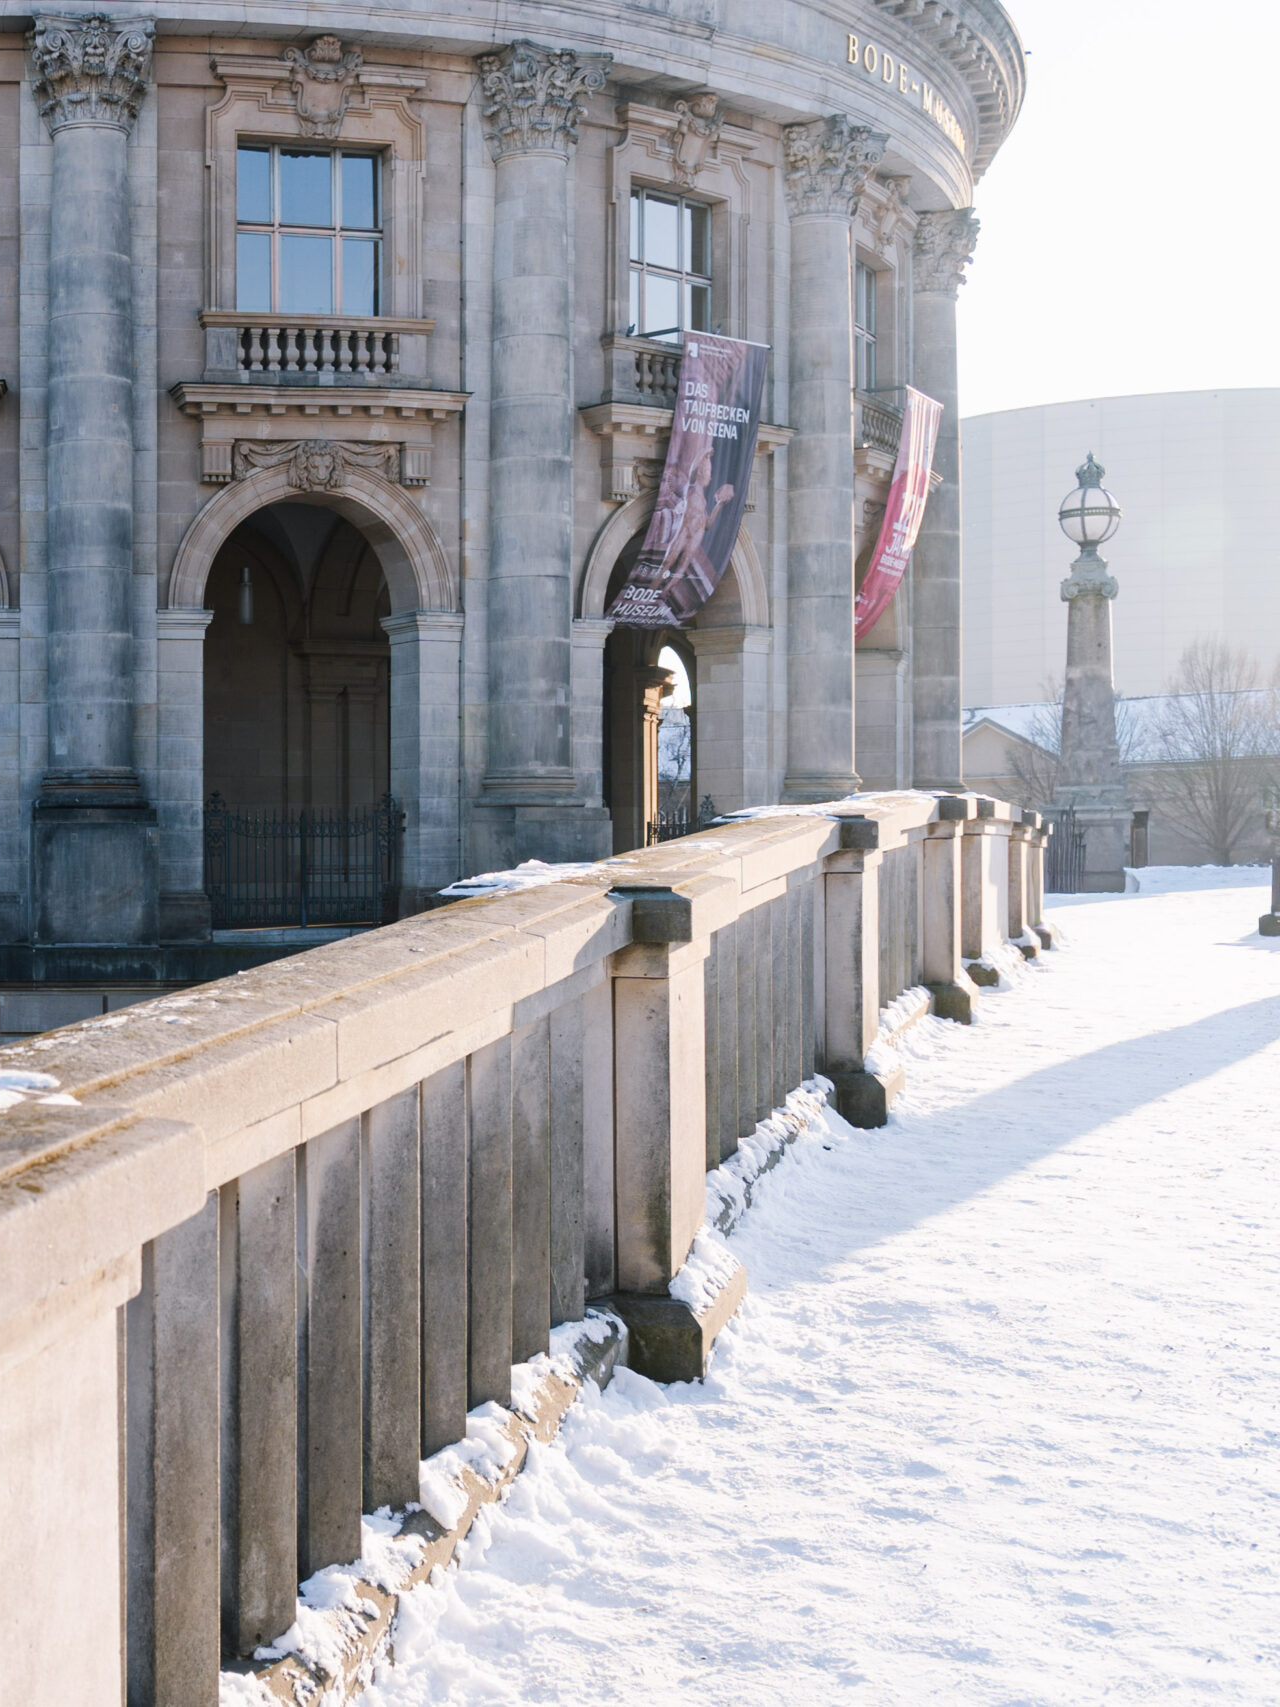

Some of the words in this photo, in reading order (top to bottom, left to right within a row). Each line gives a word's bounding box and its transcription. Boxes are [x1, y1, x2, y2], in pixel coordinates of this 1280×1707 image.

[685, 381, 708, 398] DAS
[683, 399, 750, 424] TAUFBECKEN
[681, 416, 706, 434] VON
[706, 421, 738, 440] SIENA
[624, 584, 663, 603] BODE
[612, 602, 672, 618] MUSEUM
